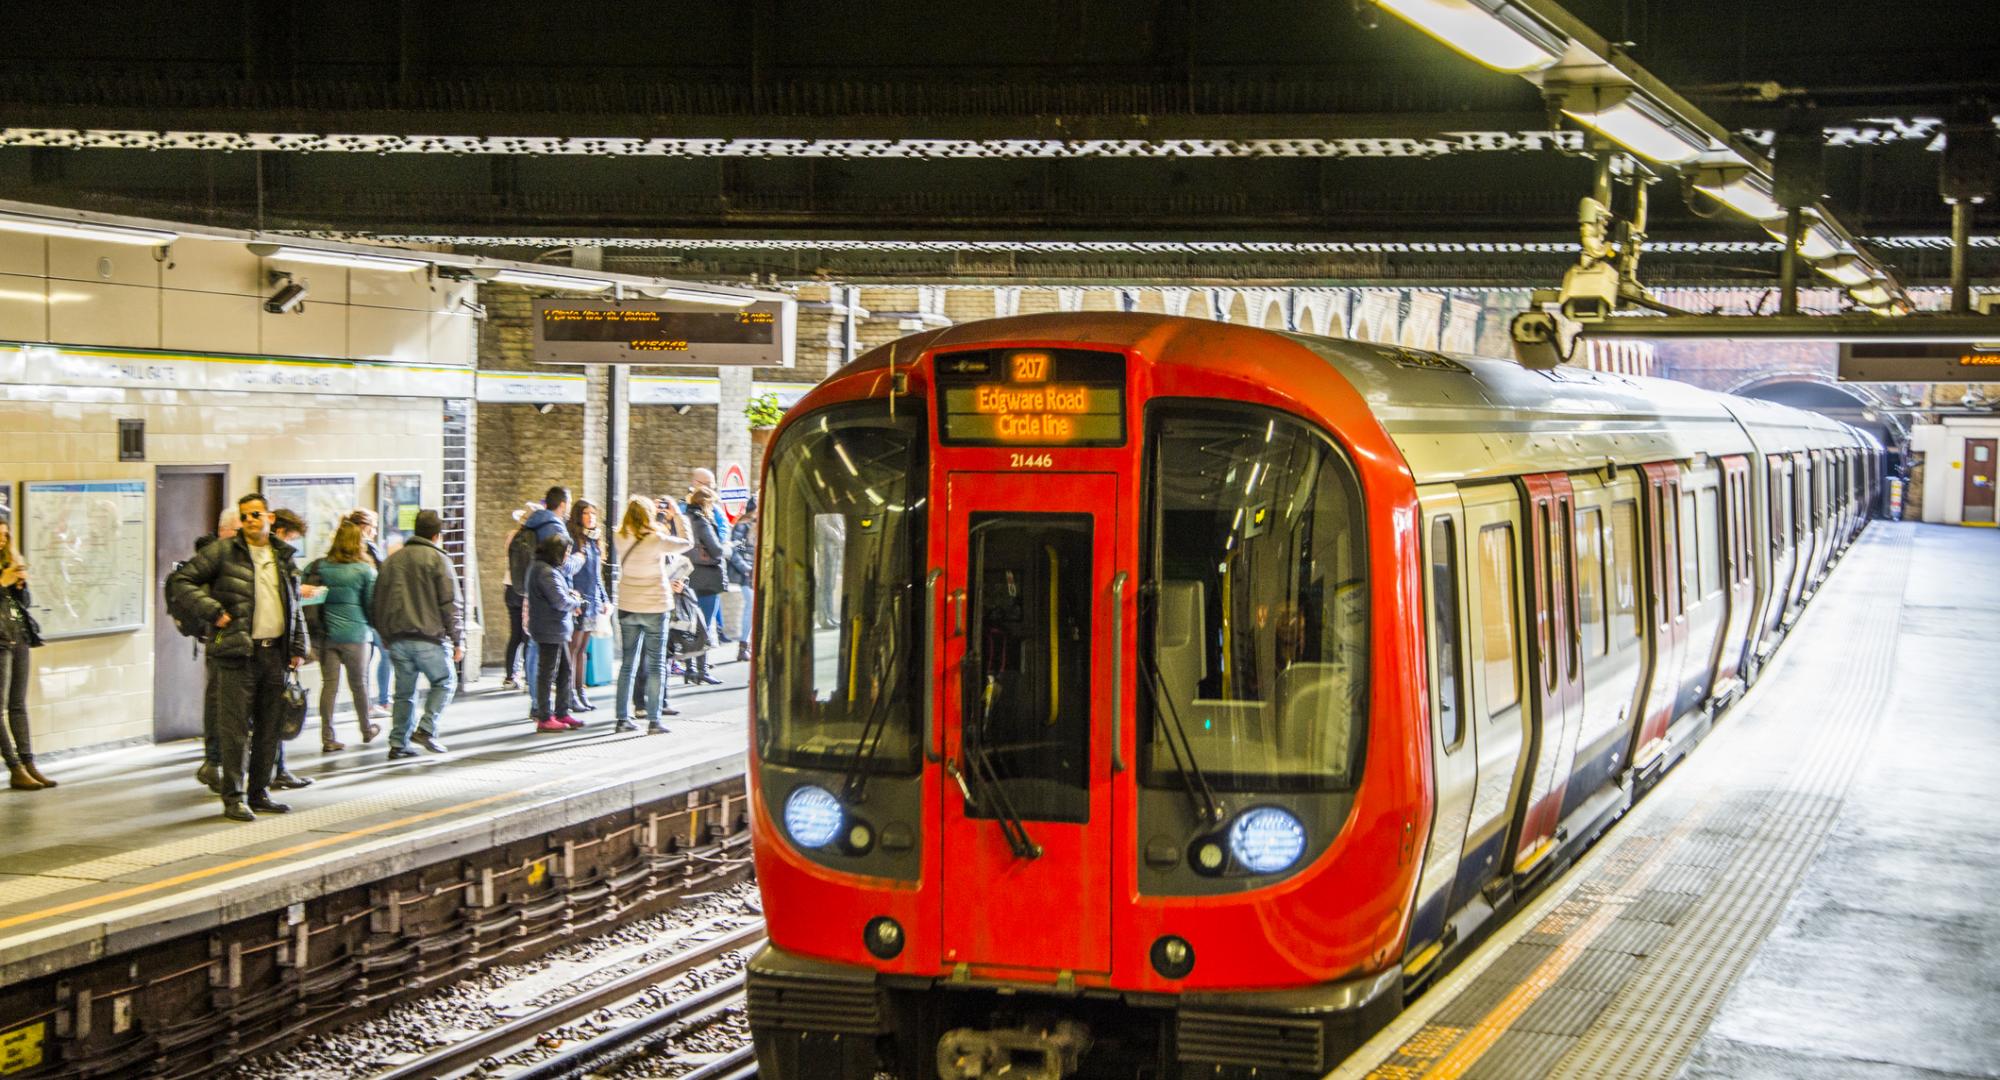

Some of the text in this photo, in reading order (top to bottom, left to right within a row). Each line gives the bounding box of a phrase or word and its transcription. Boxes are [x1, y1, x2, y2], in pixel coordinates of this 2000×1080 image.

[1017, 358, 1044, 379] 207
[978, 387, 1085, 412] Edgware Road
[999, 414, 1069, 435] Circle line
[1010, 453, 1053, 468] 21446
